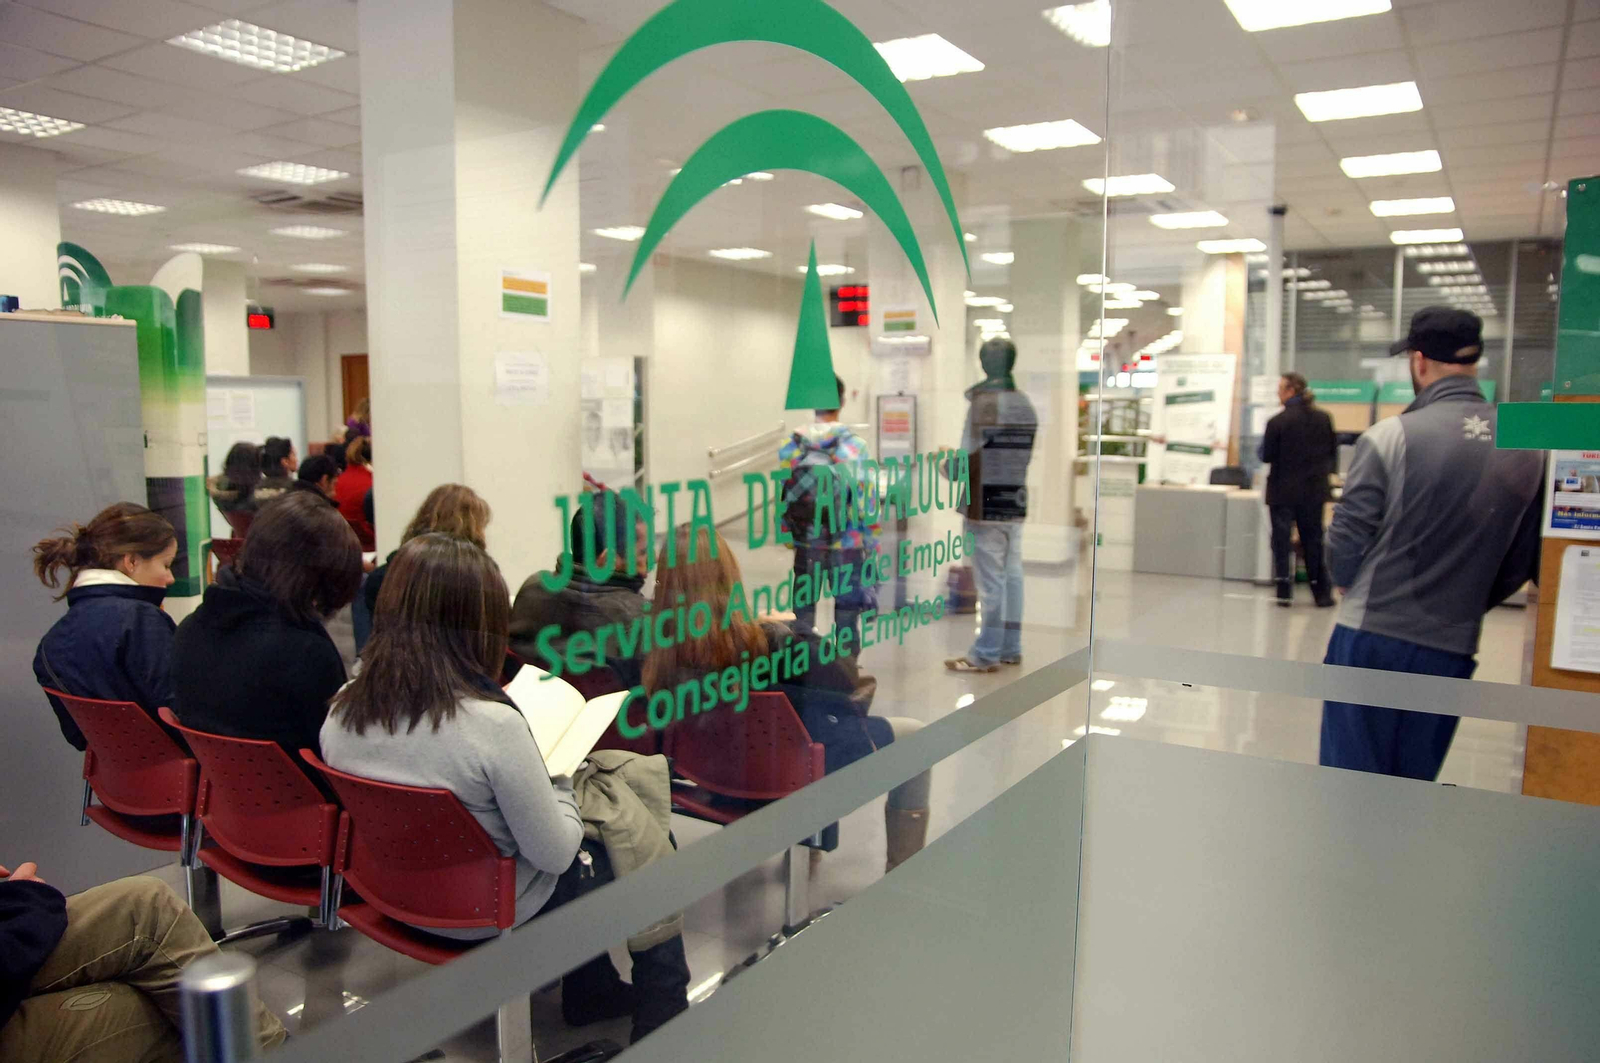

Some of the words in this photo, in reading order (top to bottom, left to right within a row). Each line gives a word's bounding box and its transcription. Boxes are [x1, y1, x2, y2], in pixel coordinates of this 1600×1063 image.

[538, 479, 719, 593] JUNTA
[743, 467, 793, 550] DE
[813, 449, 971, 538] ANDALUCIA
[536, 598, 711, 681] Servicio
[721, 563, 853, 631] Andaluz
[860, 549, 892, 588] de
[899, 530, 976, 577] Empleo
[818, 624, 854, 665] de
[860, 594, 945, 649] Empleo
